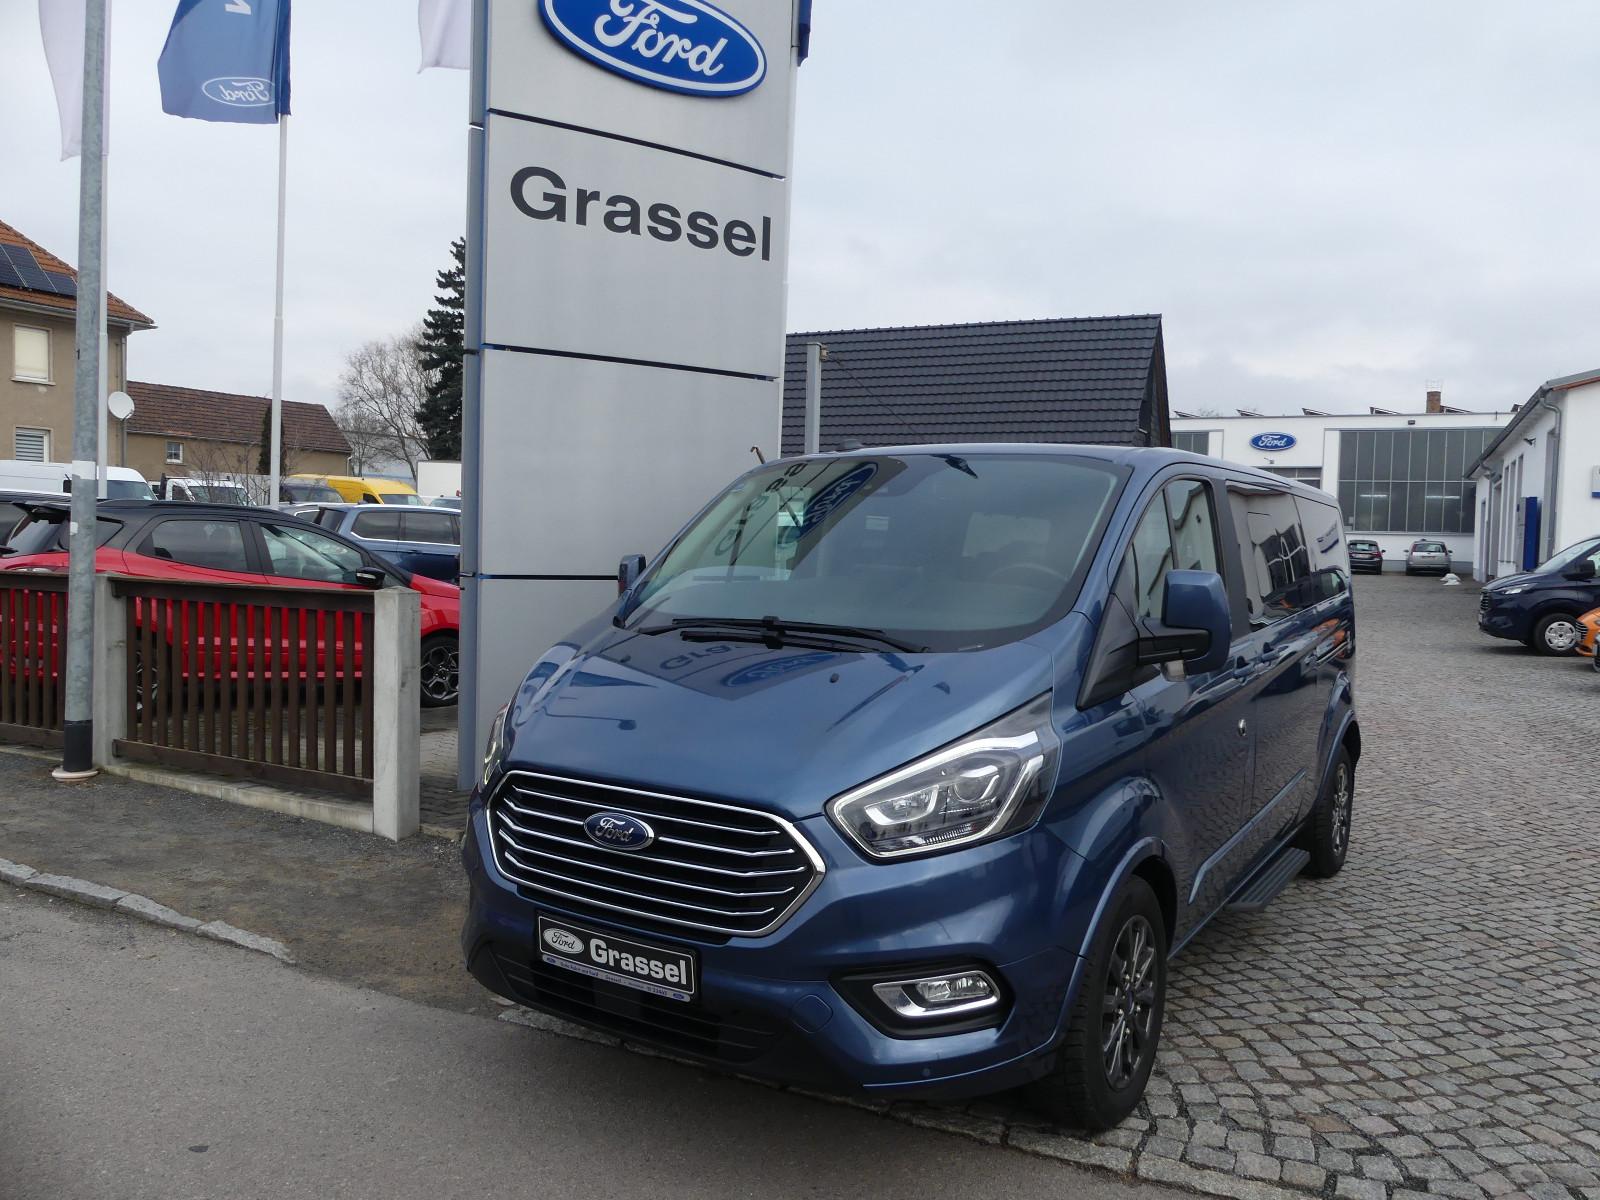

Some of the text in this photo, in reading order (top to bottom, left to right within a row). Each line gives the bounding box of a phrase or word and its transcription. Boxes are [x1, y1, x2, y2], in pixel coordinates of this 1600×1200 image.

[594, 0, 728, 76] Ford
[509, 165, 771, 262] Grassel
[1258, 434, 1288, 447] Ford
[595, 817, 634, 842] Ford
[551, 931, 576, 950] Ford
[589, 938, 687, 985] Grassel
